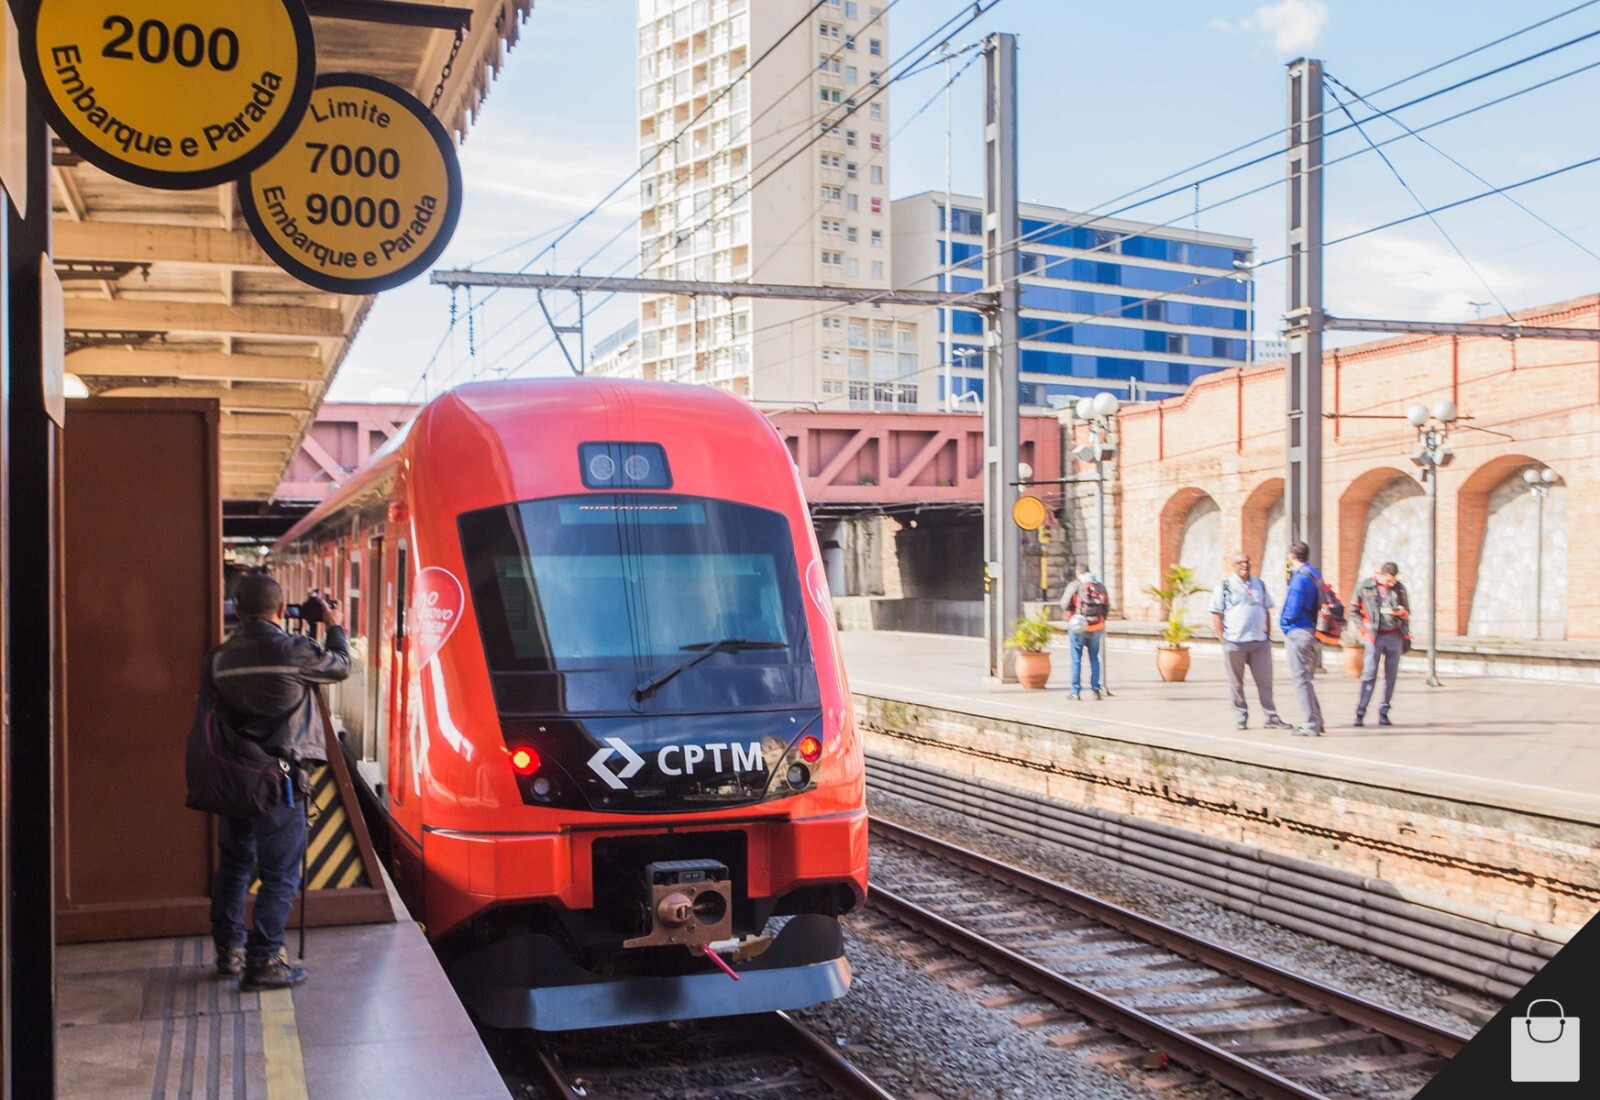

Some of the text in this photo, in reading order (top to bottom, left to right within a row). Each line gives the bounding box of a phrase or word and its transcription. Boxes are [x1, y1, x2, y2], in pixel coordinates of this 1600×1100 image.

[102, 15, 240, 71] 2000
[52, 45, 282, 158] Embarque e Parada
[310, 99, 391, 128] Limite
[306, 142, 400, 179] 7000
[263, 186, 437, 267] Embarque e Parada
[306, 194, 400, 229] 9000
[658, 742, 763, 776] CPTM
